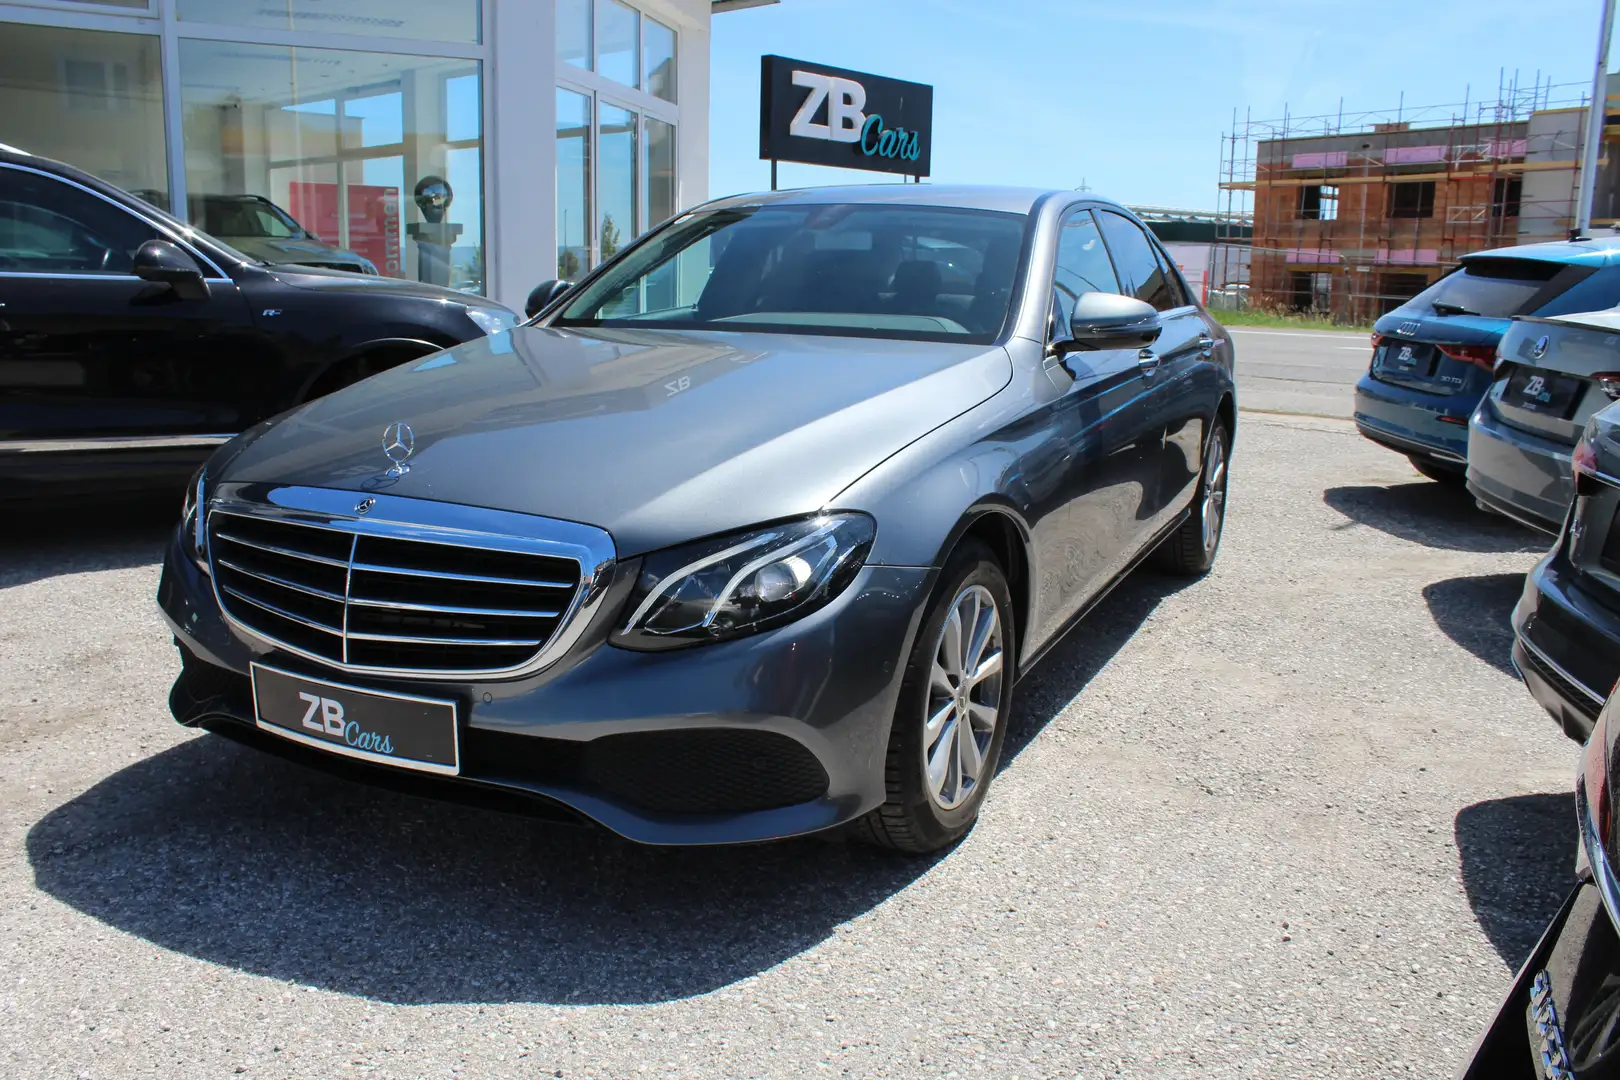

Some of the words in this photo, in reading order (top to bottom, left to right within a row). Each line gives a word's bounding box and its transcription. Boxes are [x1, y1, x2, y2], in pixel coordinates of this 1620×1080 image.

[790, 70, 867, 143] ZB
[861, 114, 920, 161] Cars
[1398, 347, 1412, 360] ZB
[1523, 376, 1544, 395] ZB
[299, 692, 346, 736] ZB
[345, 722, 393, 753] Cars
